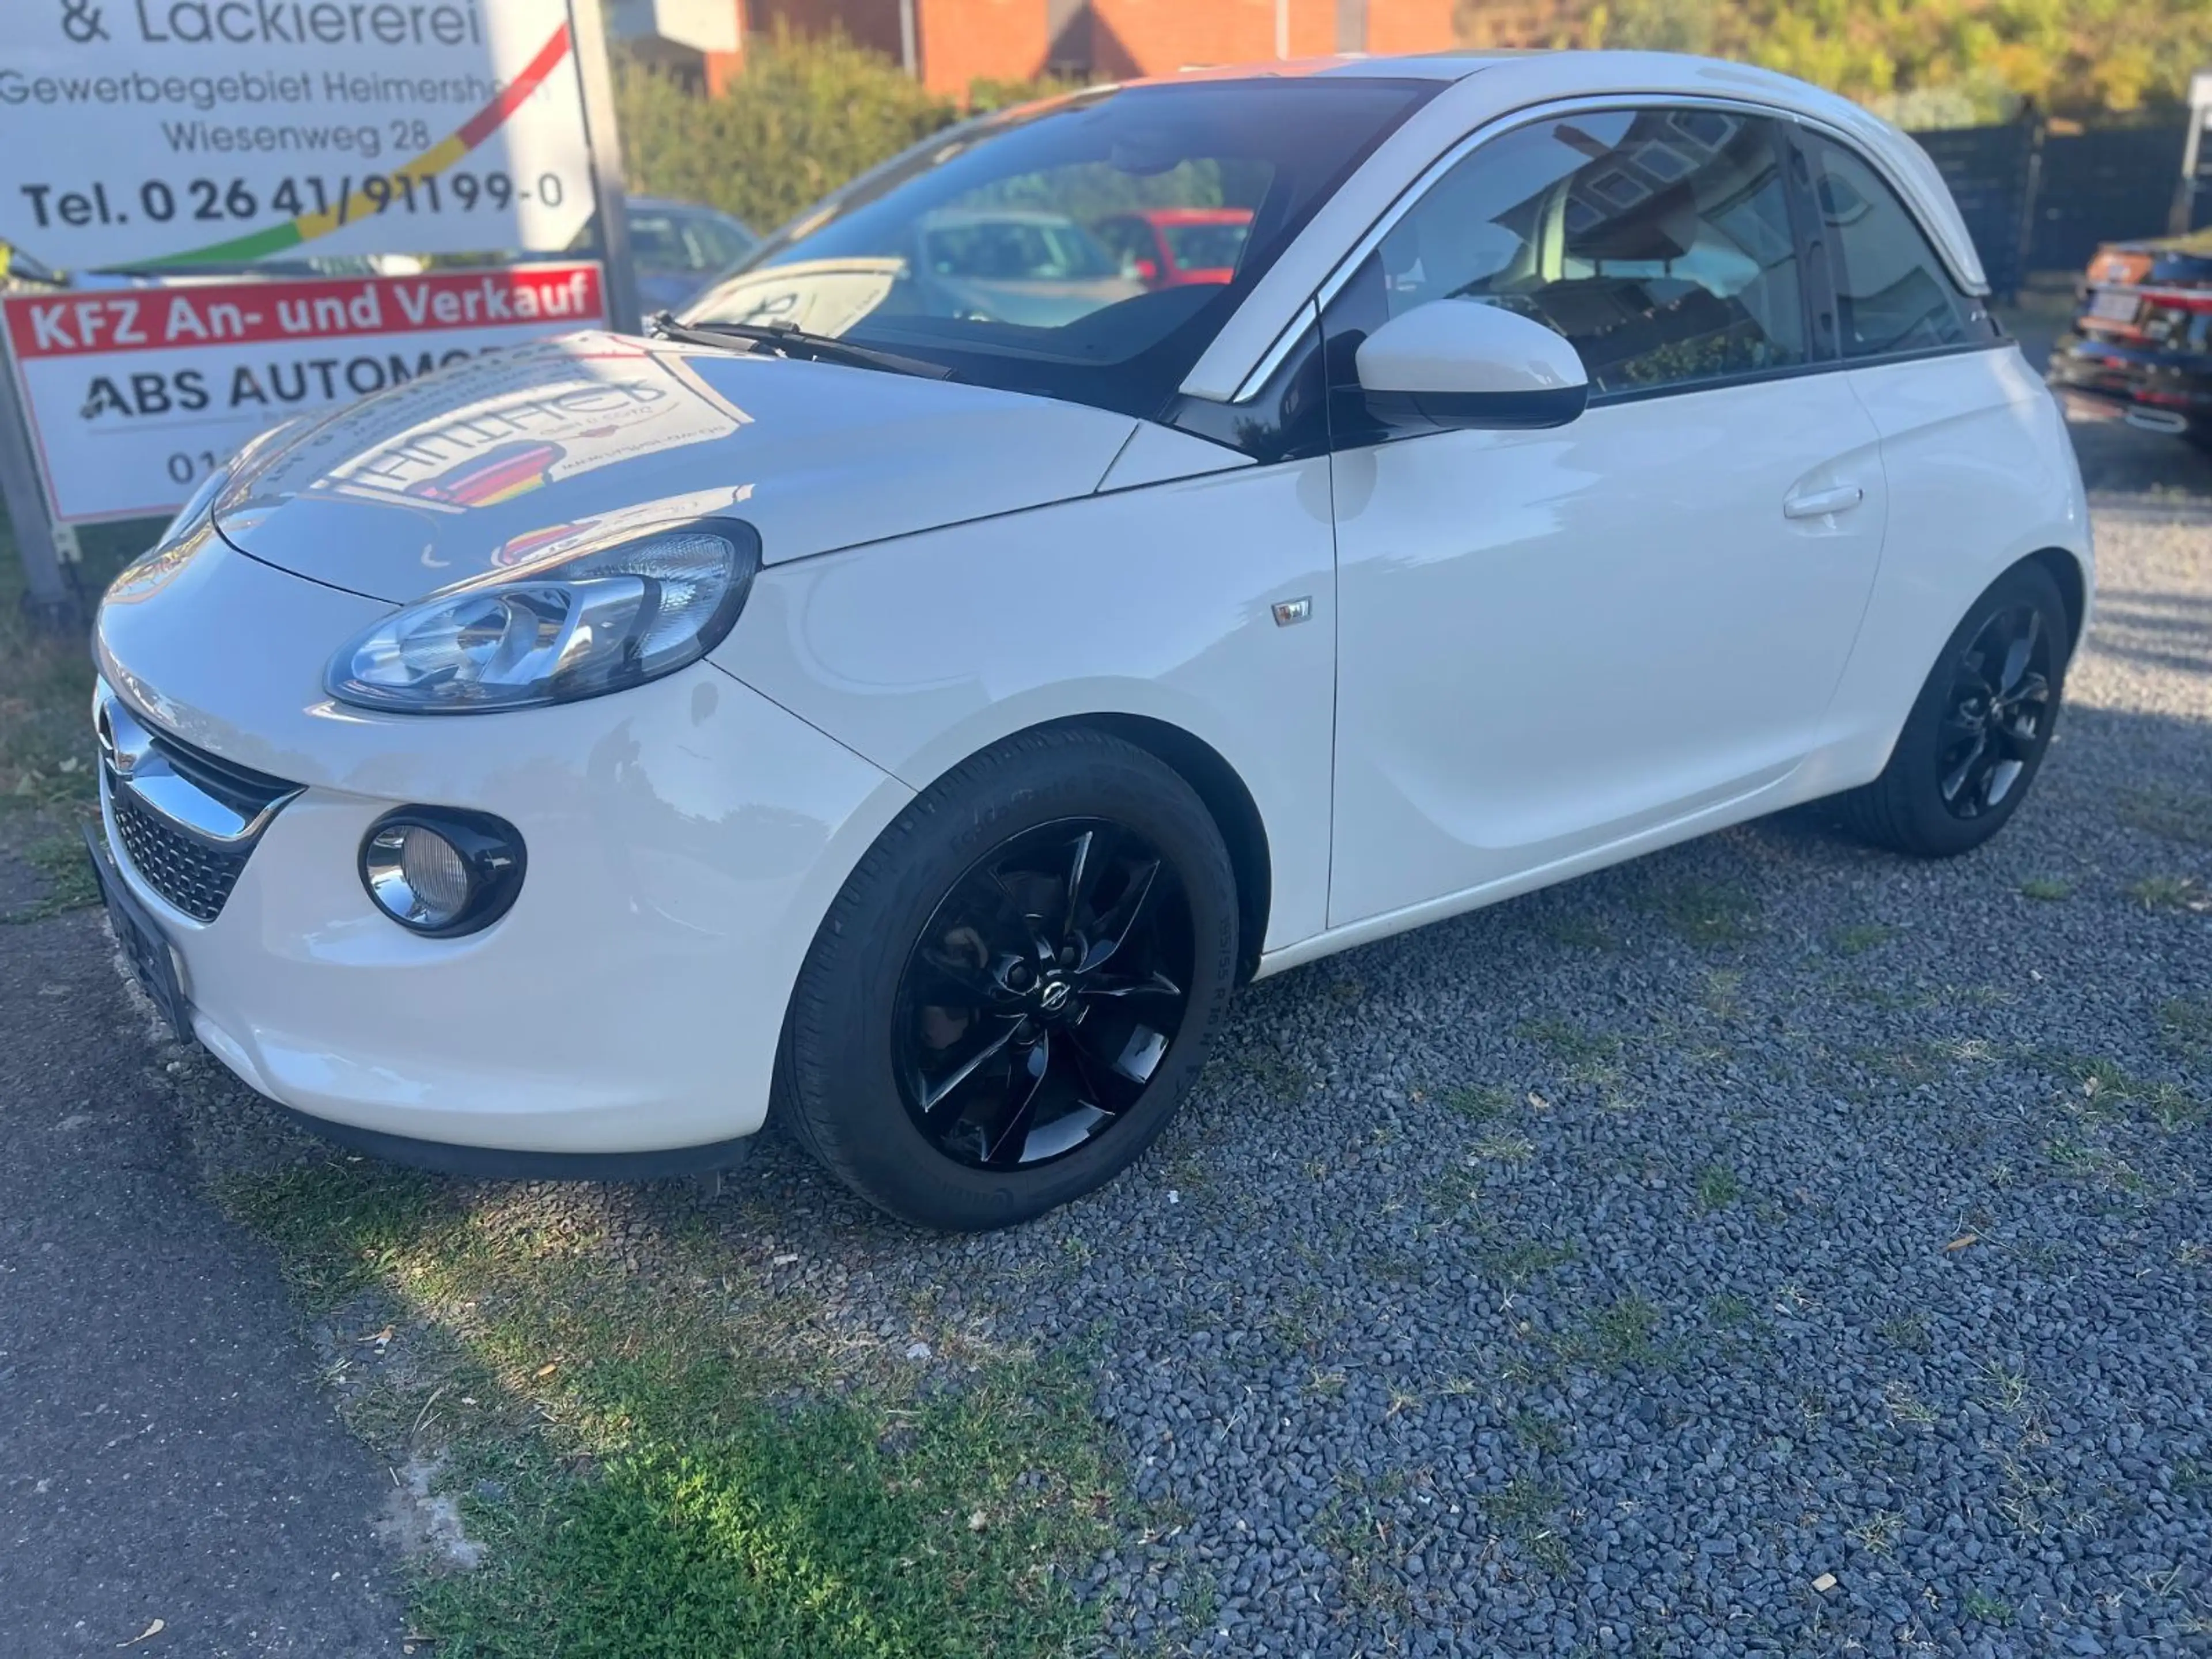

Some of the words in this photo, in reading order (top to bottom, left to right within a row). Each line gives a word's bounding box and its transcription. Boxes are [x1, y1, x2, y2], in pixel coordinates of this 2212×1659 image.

[61, 0, 111, 43] &
[135, 0, 480, 45] Lackiererei
[0, 69, 312, 111] Gewerbegebiet
[161, 120, 381, 158] Wiesenweg
[391, 119, 432, 151] 28
[20, 181, 129, 228] Tel.
[29, 299, 148, 350] KFZ
[165, 296, 263, 341] An-
[276, 283, 382, 333] und
[393, 270, 590, 325] Verkauf
[79, 368, 211, 420] ABS
